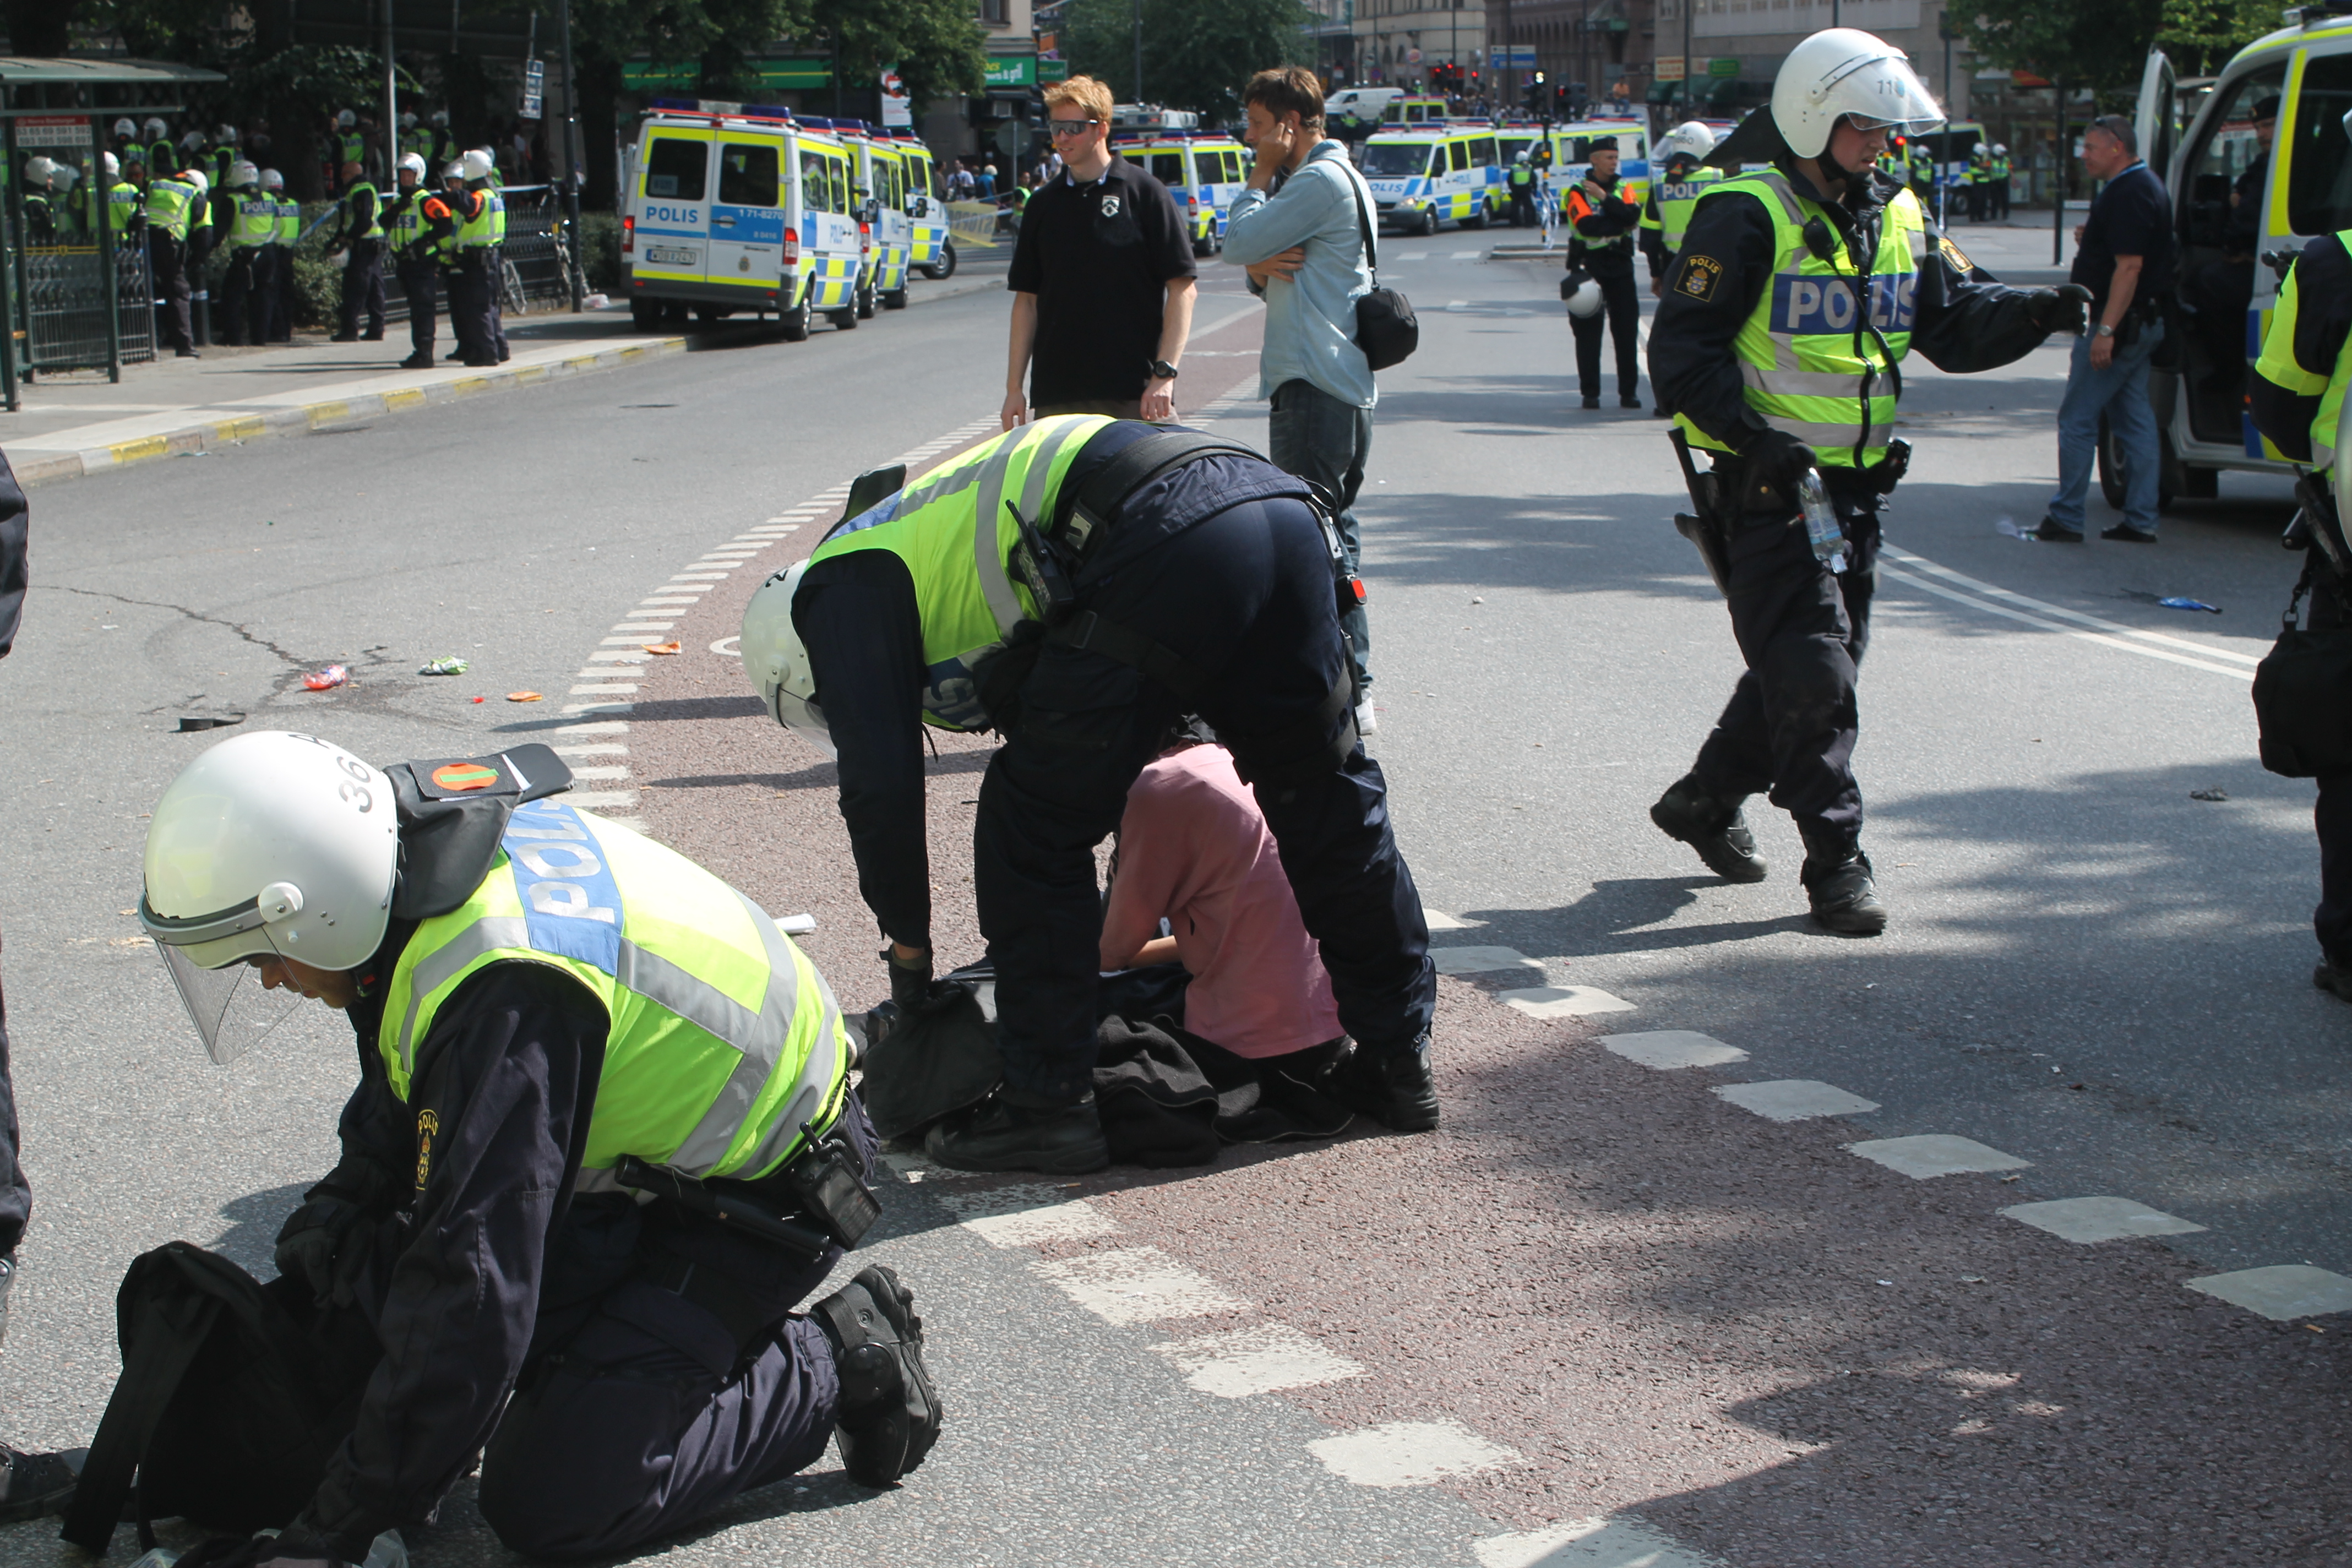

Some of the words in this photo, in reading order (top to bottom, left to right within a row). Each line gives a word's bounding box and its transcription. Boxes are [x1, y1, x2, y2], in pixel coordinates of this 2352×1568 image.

[1371, 183, 1403, 192] OLIS
[646, 206, 698, 223] POLIS
[739, 209, 744, 217] 1
[1690, 258, 1720, 274] POLIS
[1787, 280, 1917, 329] POLIS
[418, 1114, 438, 1136] POLIS
